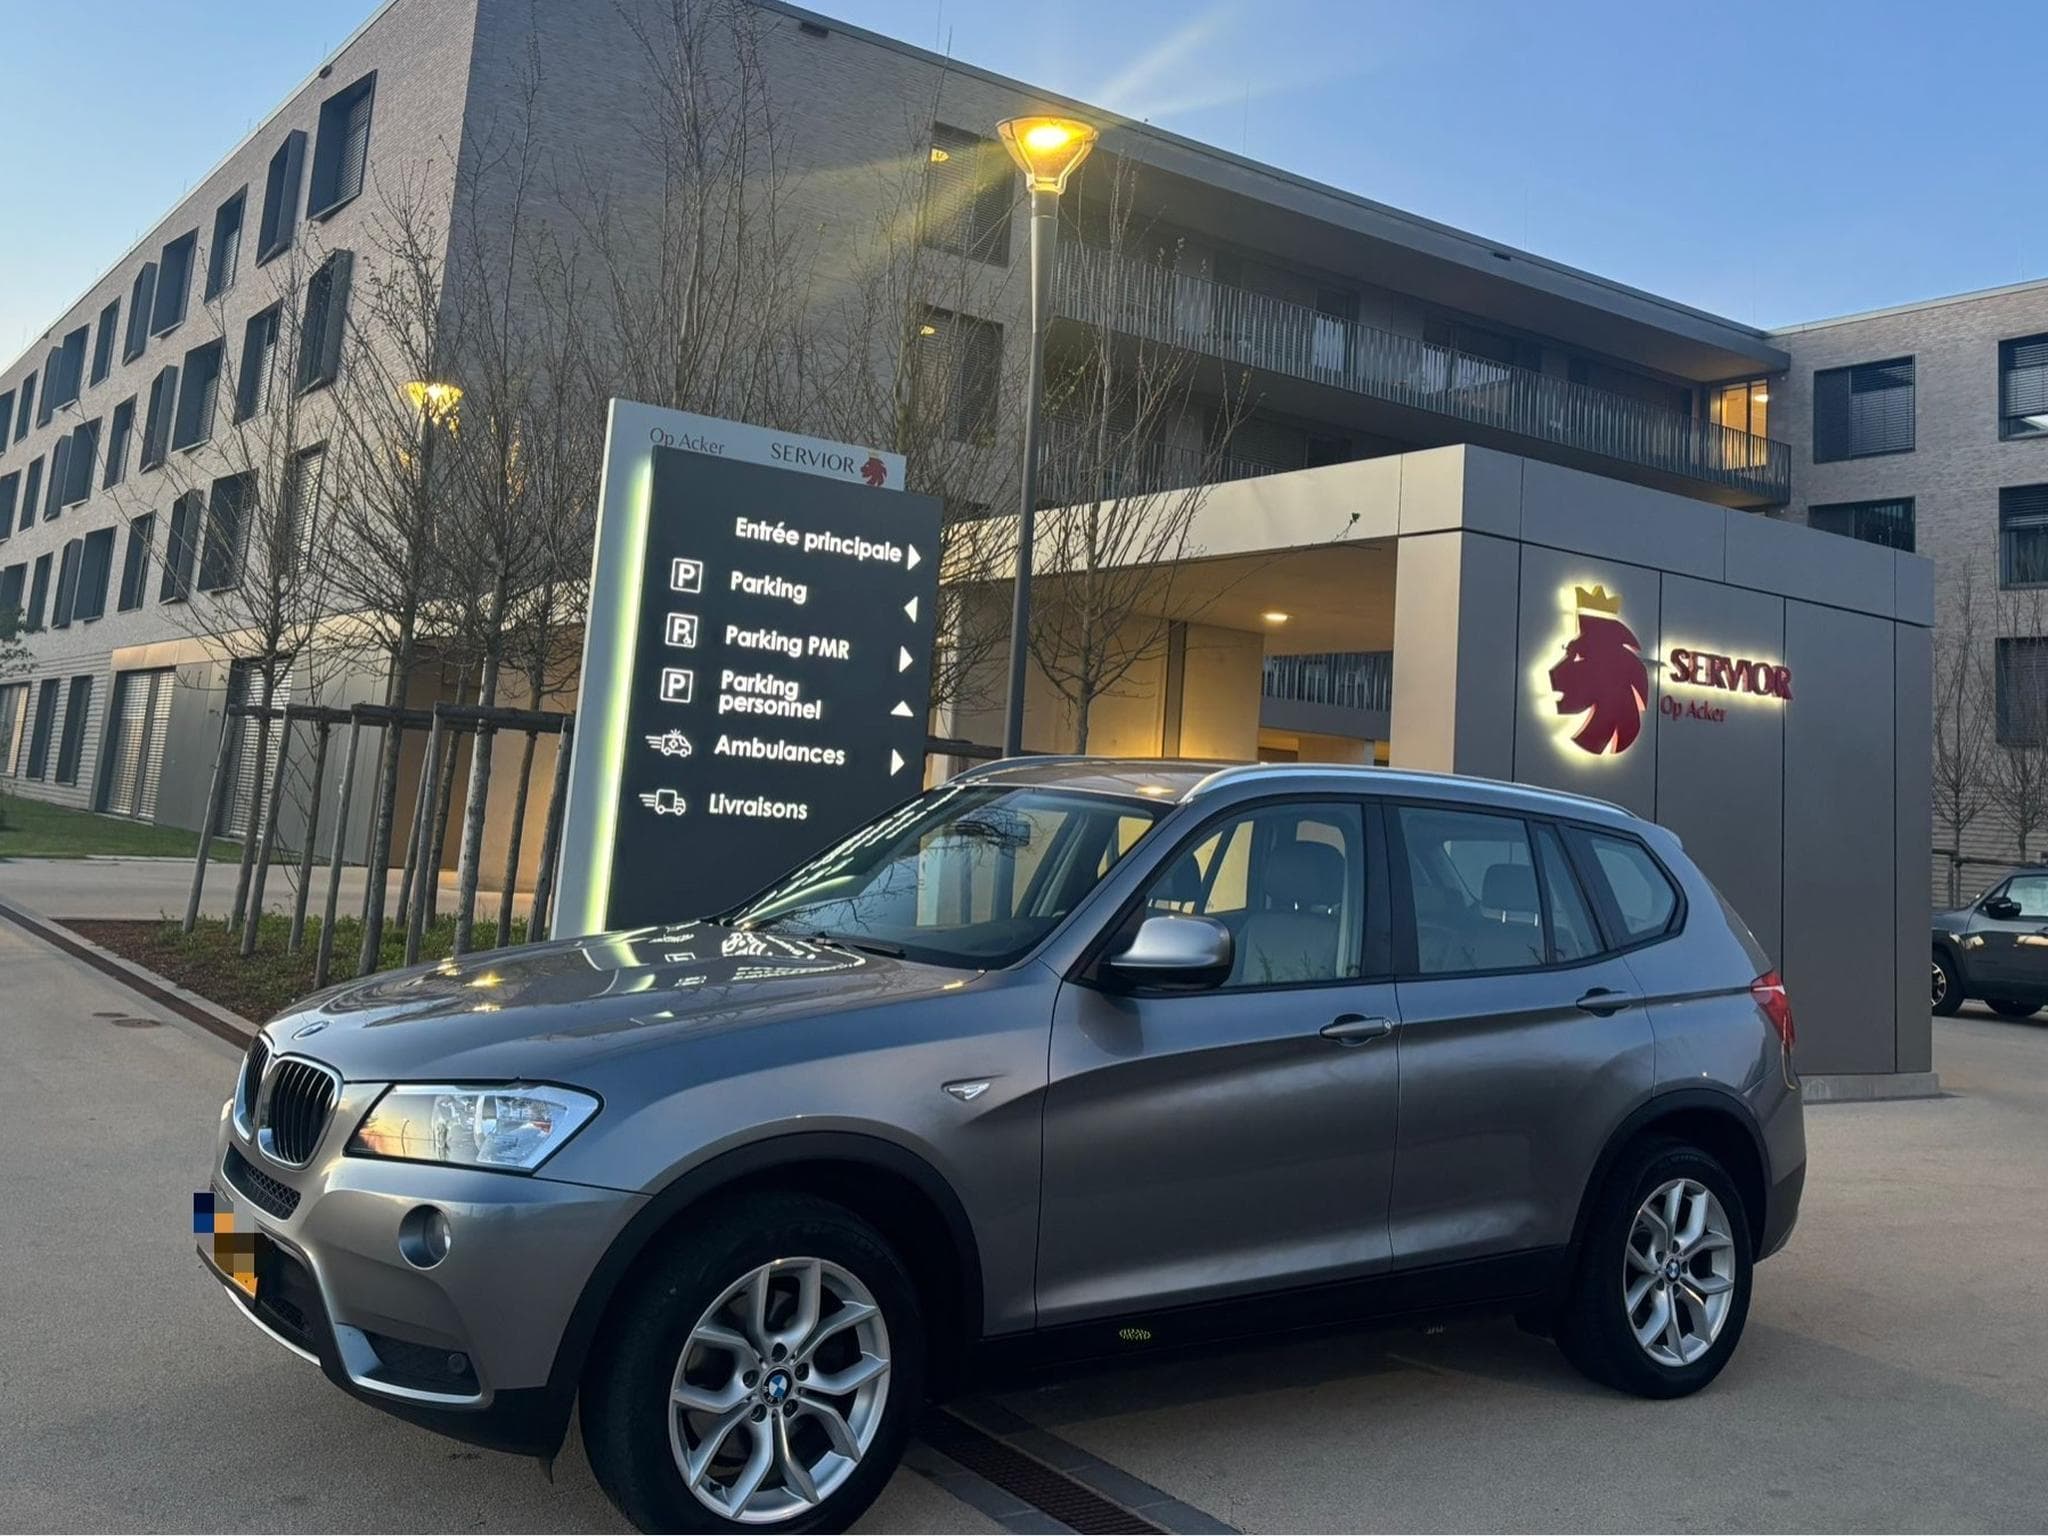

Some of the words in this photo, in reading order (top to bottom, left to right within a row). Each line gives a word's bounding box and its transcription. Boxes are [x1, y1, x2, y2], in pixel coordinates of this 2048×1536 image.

[650, 427, 674, 448] Op
[679, 433, 725, 455] Acker
[770, 442, 854, 474] SERVIOR
[735, 517, 800, 546] Entrée
[803, 532, 903, 563] principale
[677, 563, 696, 588] P
[730, 571, 808, 604] Parking
[725, 625, 802, 658] Parking
[808, 636, 850, 660] PMR
[667, 673, 686, 698] P
[721, 670, 799, 701] Parking
[1669, 648, 1793, 700] SERVIOR
[718, 693, 822, 720] personnel
[1660, 695, 1681, 720] Op
[1686, 700, 1727, 723] Acker
[714, 735, 846, 766] Ambulances
[708, 794, 808, 820] Livraisons
